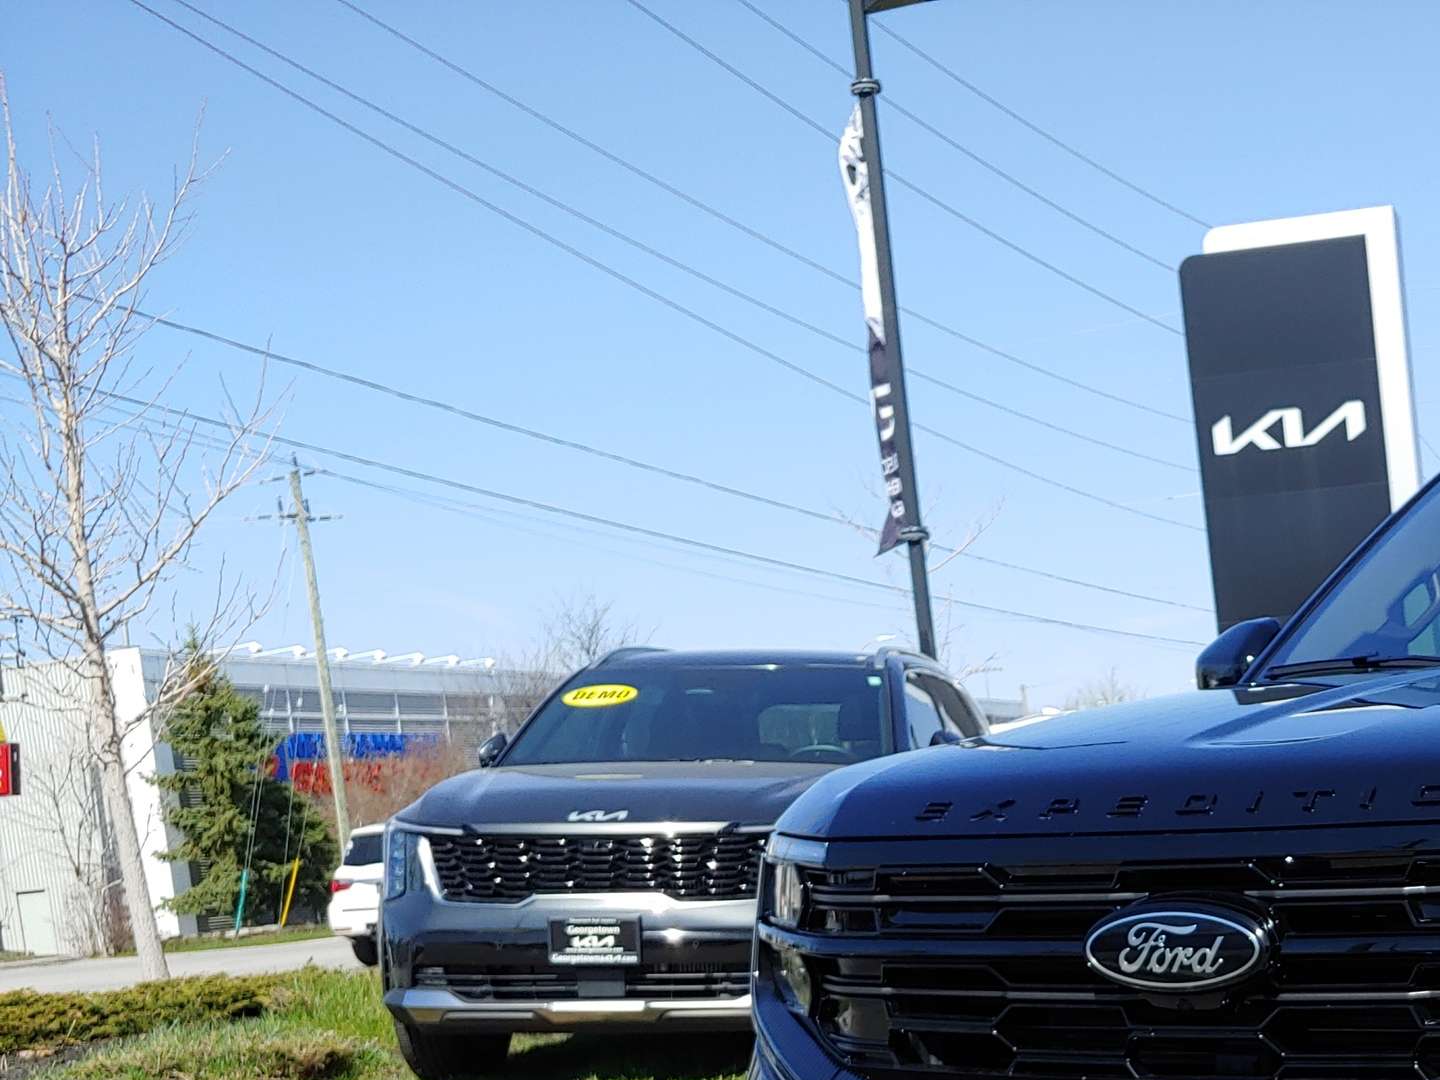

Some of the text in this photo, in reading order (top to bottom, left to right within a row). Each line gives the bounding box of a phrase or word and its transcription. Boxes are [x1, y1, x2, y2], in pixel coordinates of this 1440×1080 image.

[1211, 400, 1366, 455] KIA
[572, 690, 631, 701] DEMO
[567, 809, 629, 822] KIA
[1118, 922, 1224, 974] Ford
